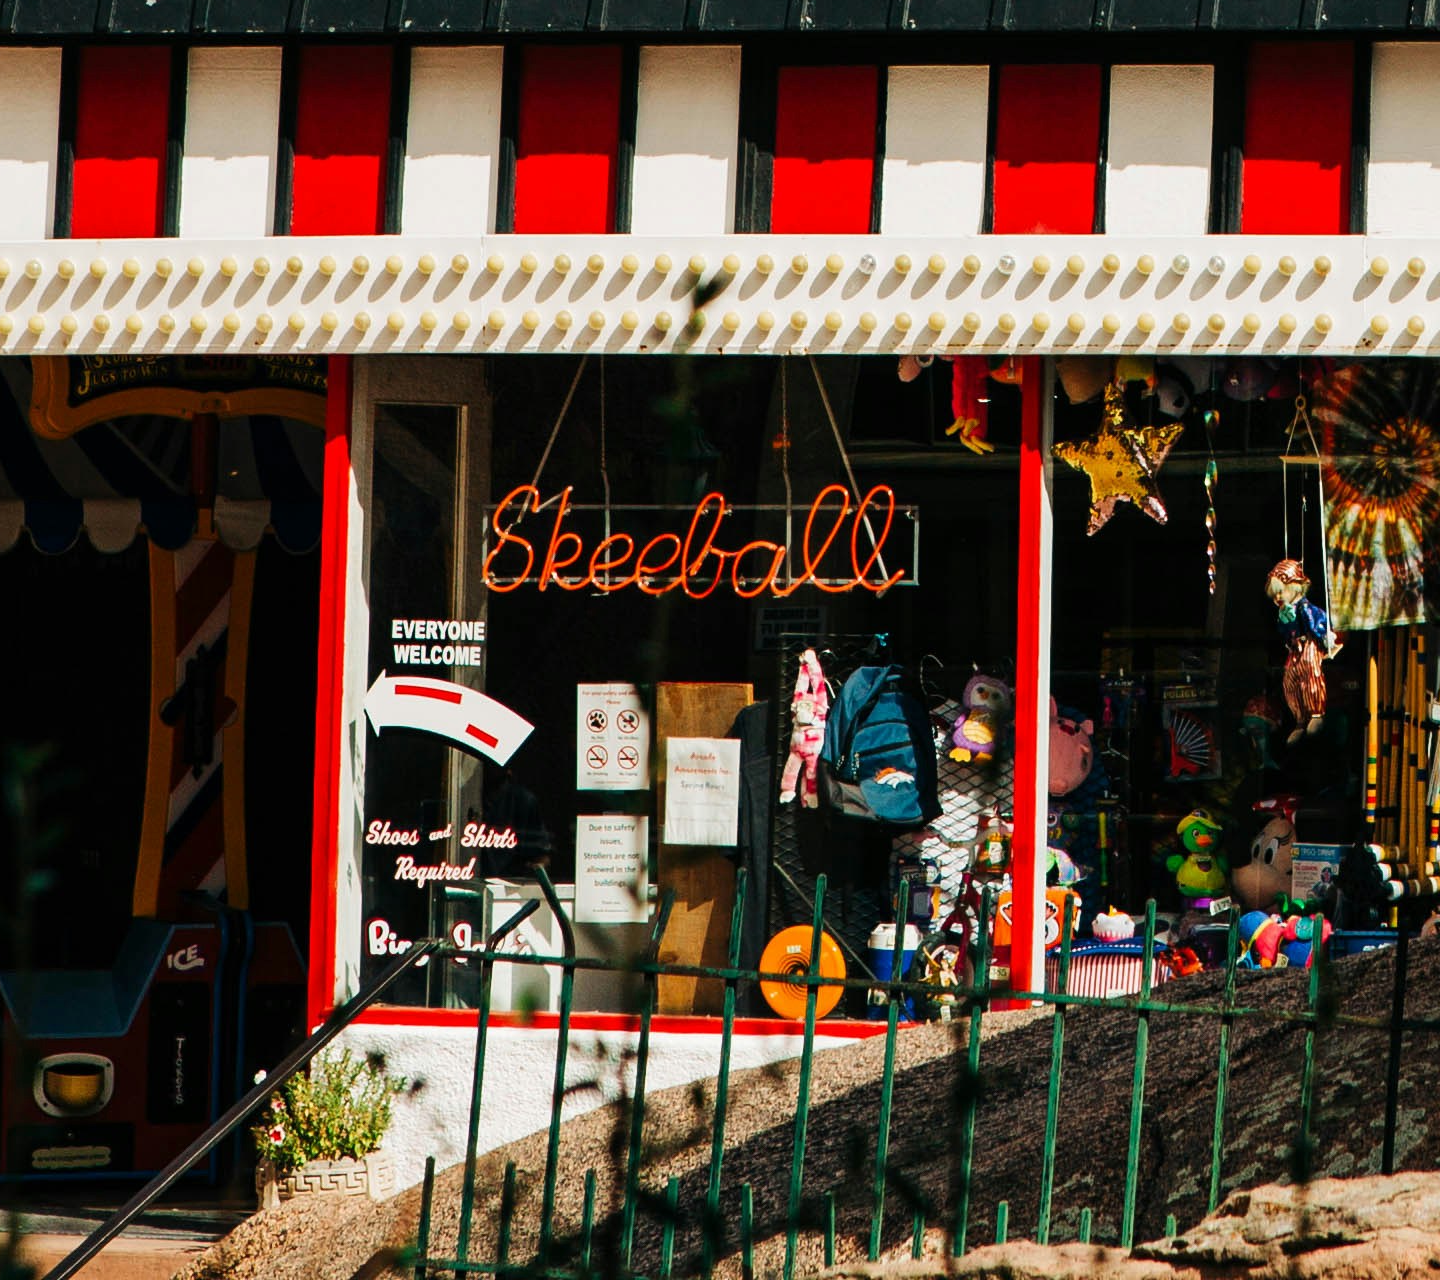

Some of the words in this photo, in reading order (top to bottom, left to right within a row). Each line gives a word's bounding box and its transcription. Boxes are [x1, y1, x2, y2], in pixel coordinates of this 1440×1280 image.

[483, 483, 905, 598] Skeeball
[391, 619, 486, 641] EVERYONE
[393, 644, 482, 667] WELCOME
[366, 820, 420, 846] Shoes
[429, 824, 453, 841] and
[460, 822, 518, 849] Shirts
[394, 855, 477, 889] Required
